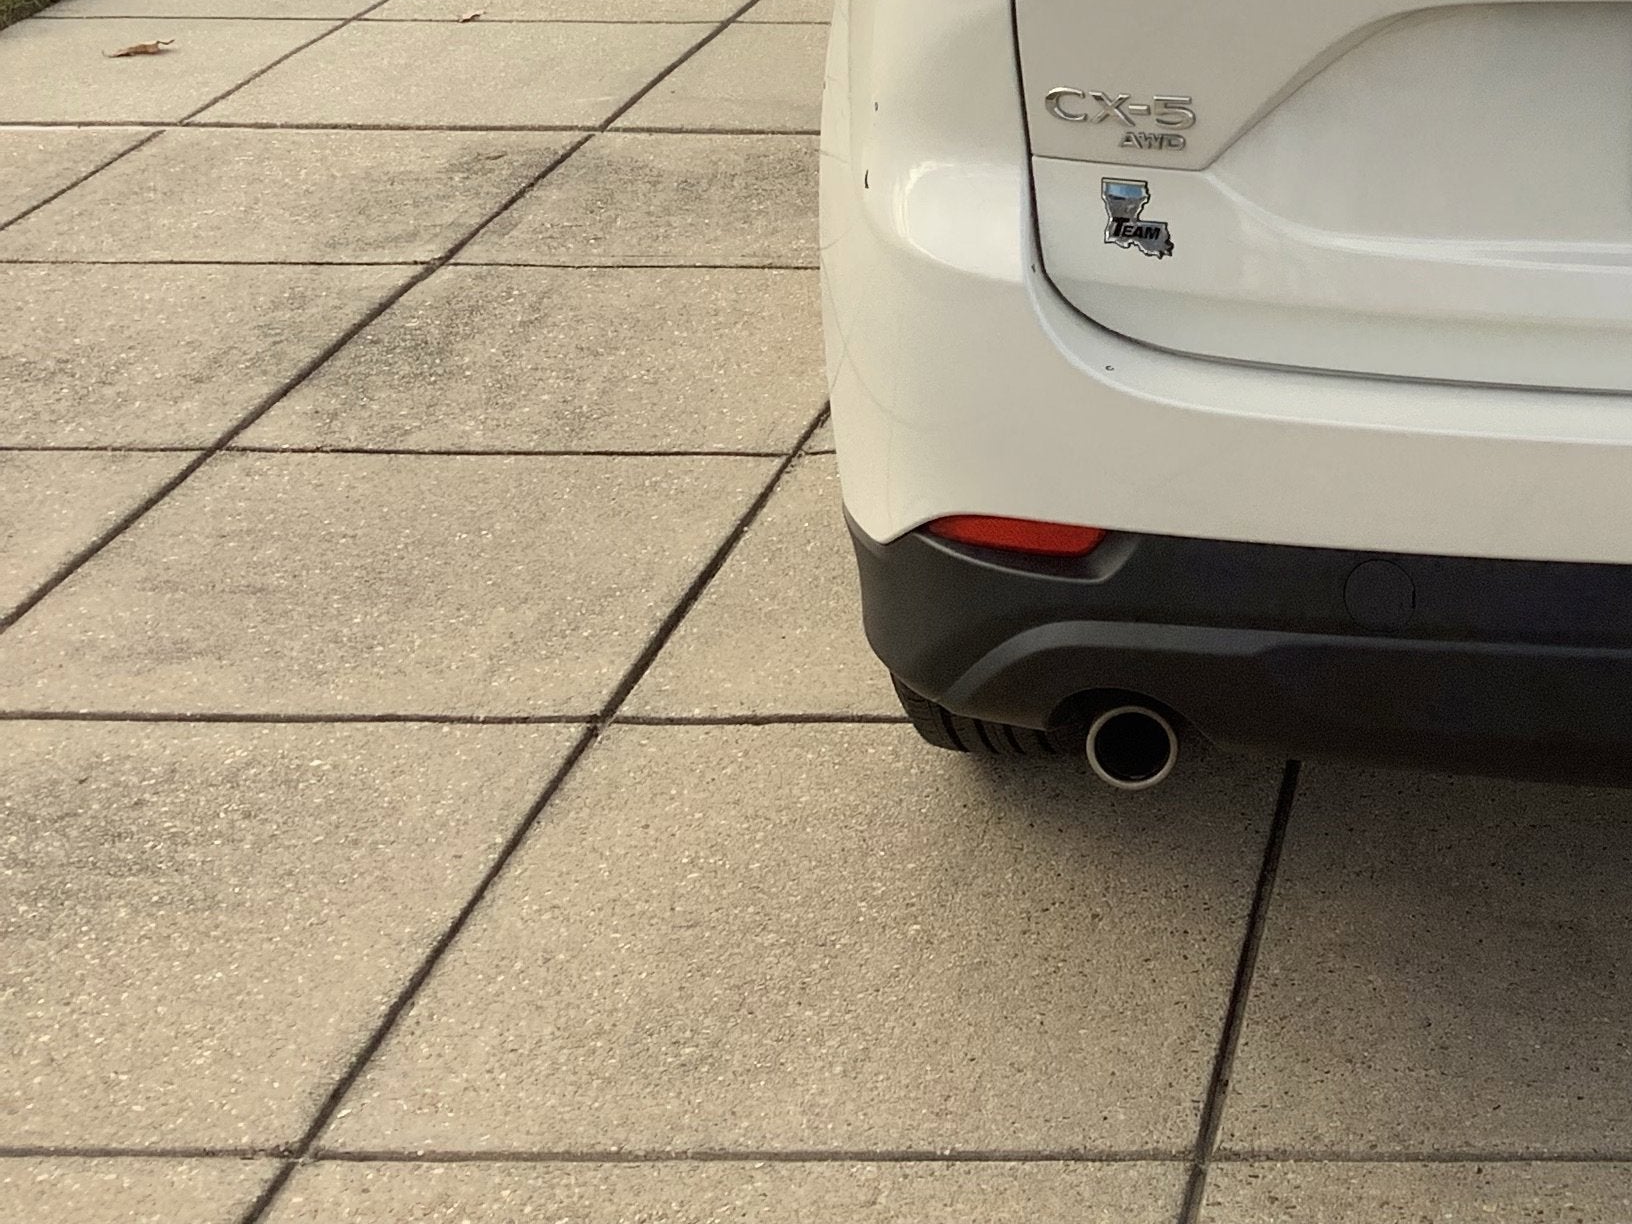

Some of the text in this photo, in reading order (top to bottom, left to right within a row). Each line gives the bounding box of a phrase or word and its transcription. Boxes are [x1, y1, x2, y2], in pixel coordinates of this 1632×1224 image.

[1045, 86, 1197, 131] CX-5
[1119, 131, 1187, 152] AWD
[1110, 216, 1161, 241] TEAM
